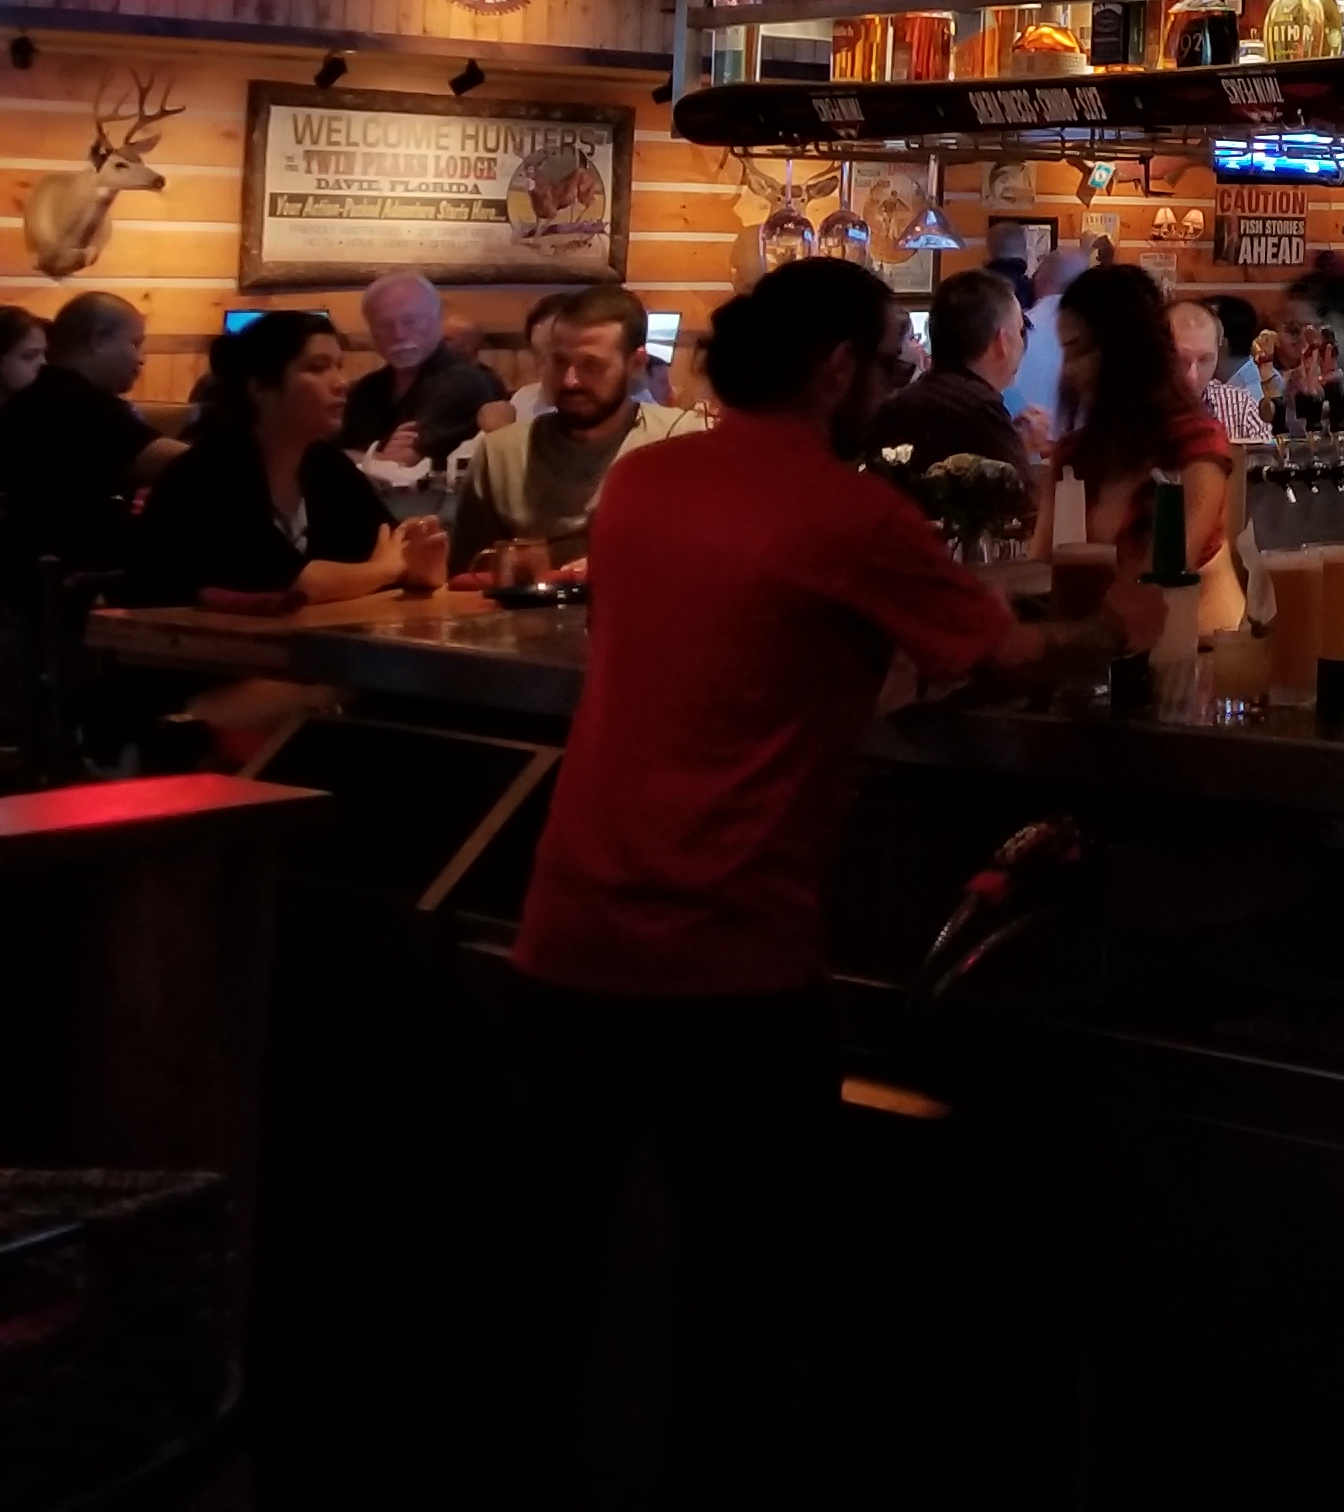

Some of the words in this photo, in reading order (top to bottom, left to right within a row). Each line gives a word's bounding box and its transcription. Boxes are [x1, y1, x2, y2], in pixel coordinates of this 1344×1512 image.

[291, 112, 450, 149] WELCOME
[460, 123, 596, 157] HUNTERS
[303, 149, 357, 176] TWIN
[361, 152, 428, 180] PEAKS
[432, 155, 498, 181] LODGE
[388, 179, 483, 196] FLORIDA
[1219, 189, 1308, 215] CAUTION
[1240, 219, 1263, 236] FISH
[1265, 219, 1305, 236] STORIES
[1238, 236, 1305, 266] AHEAD
